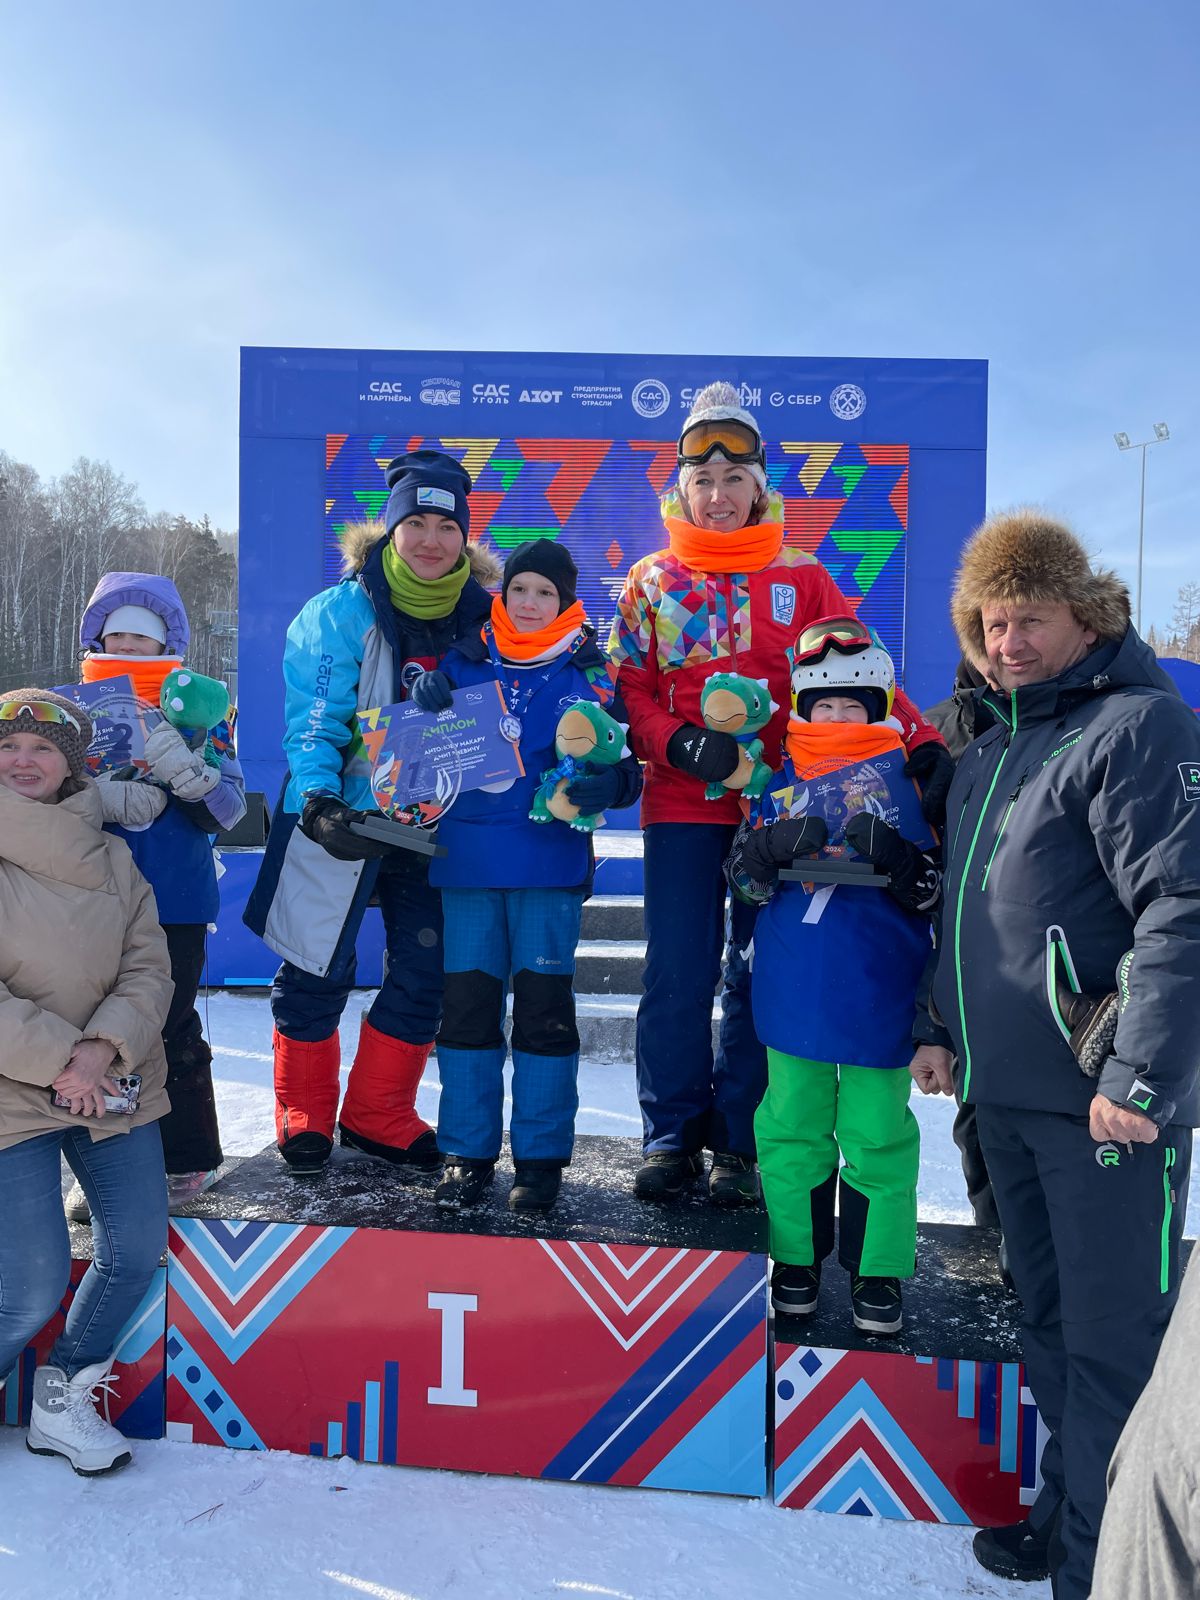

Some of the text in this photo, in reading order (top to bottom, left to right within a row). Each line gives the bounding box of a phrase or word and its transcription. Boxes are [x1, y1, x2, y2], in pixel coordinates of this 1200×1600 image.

[369, 382, 402, 393] СДС
[472, 384, 510, 397] СДС
[367, 393, 412, 403] ПАРТНЁРЫ
[420, 389, 460, 406] СДС
[472, 396, 509, 404] УГОЛЬ
[518, 390, 563, 403] АЗОТ
[571, 392, 623, 400] СТРОИТЕЛЬНОЙ
[640, 392, 662, 400] СДС
[787, 394, 822, 405] СБЕР
[315, 653, 334, 698] 2023
